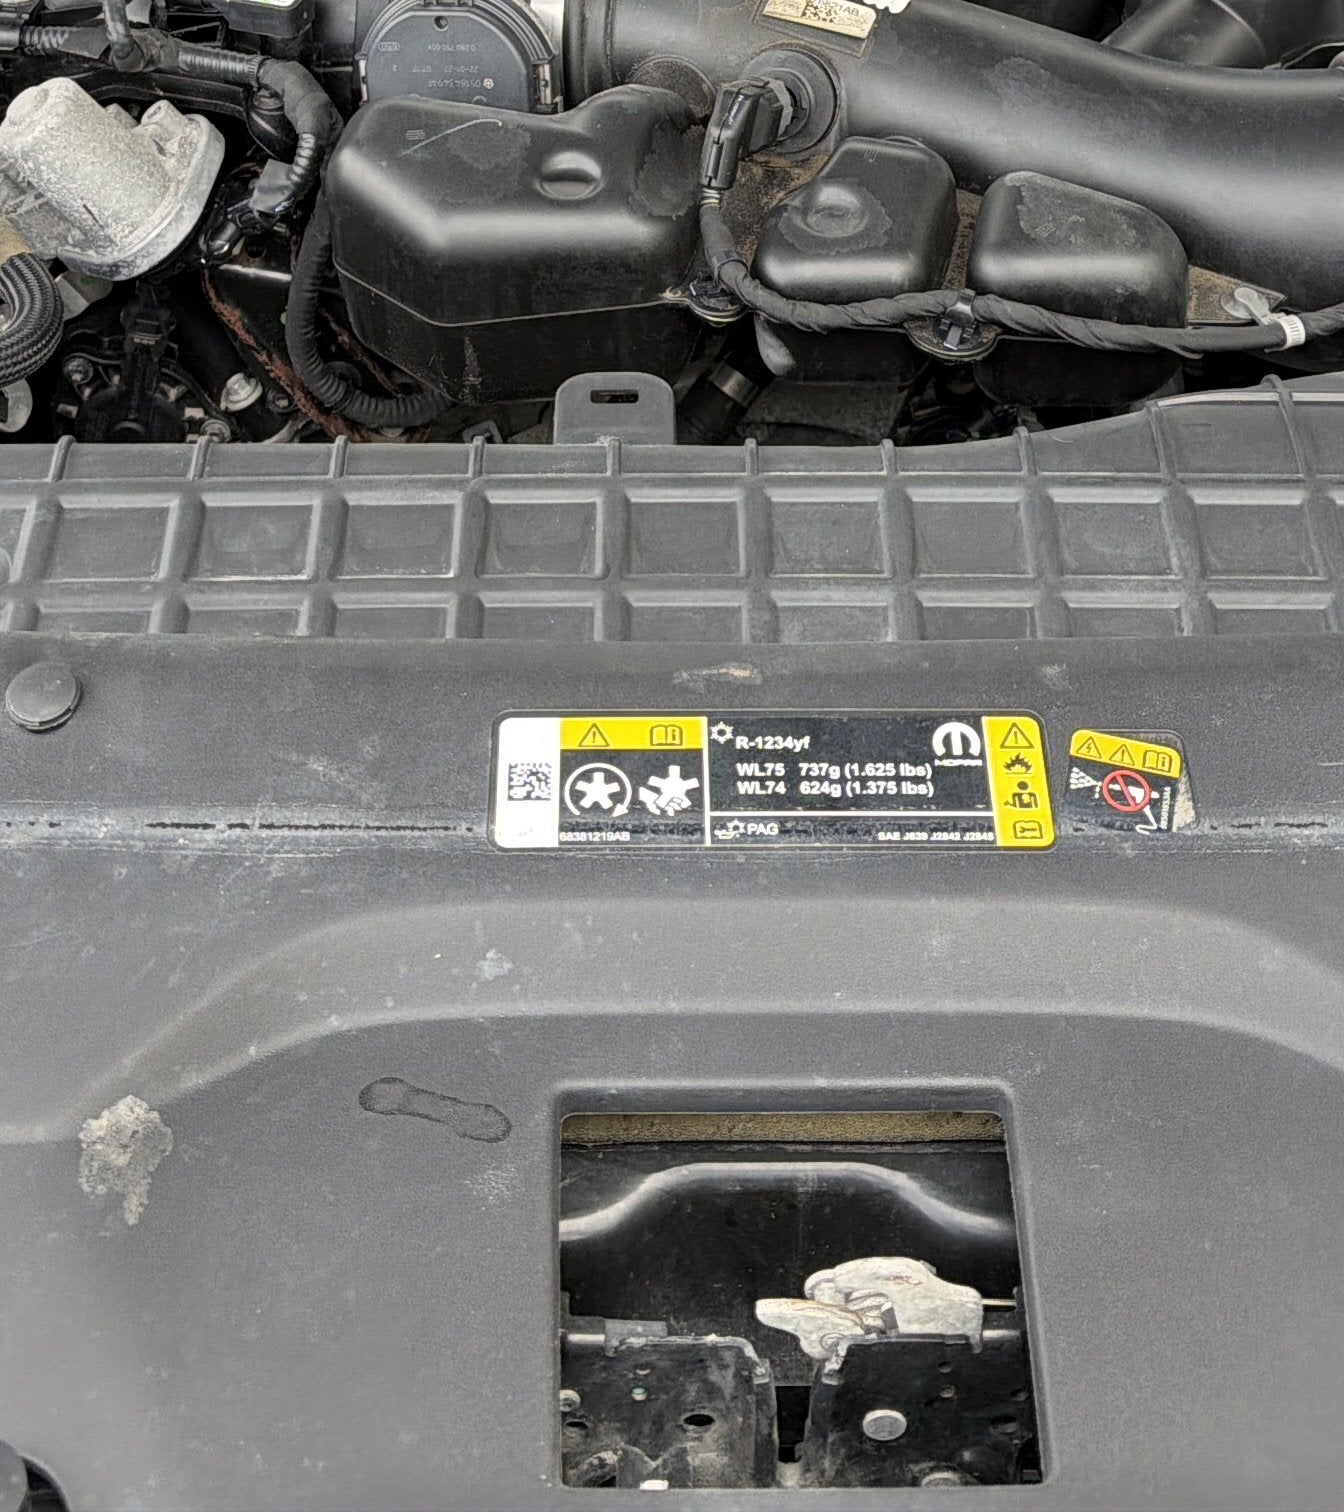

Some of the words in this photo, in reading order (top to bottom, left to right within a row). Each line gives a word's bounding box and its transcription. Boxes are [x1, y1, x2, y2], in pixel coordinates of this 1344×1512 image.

[735, 736, 811, 753] R-1234yf
[736, 762, 786, 777] WL75
[799, 762, 841, 780] 737g
[844, 762, 897, 780] (1.625
[900, 762, 933, 780] lbs)
[736, 780, 787, 795] WL74
[799, 780, 842, 798] 624g
[845, 780, 898, 798] (1.375
[901, 780, 935, 798] lbs)
[746, 822, 780, 836] PAG
[877, 831, 901, 841] SAE
